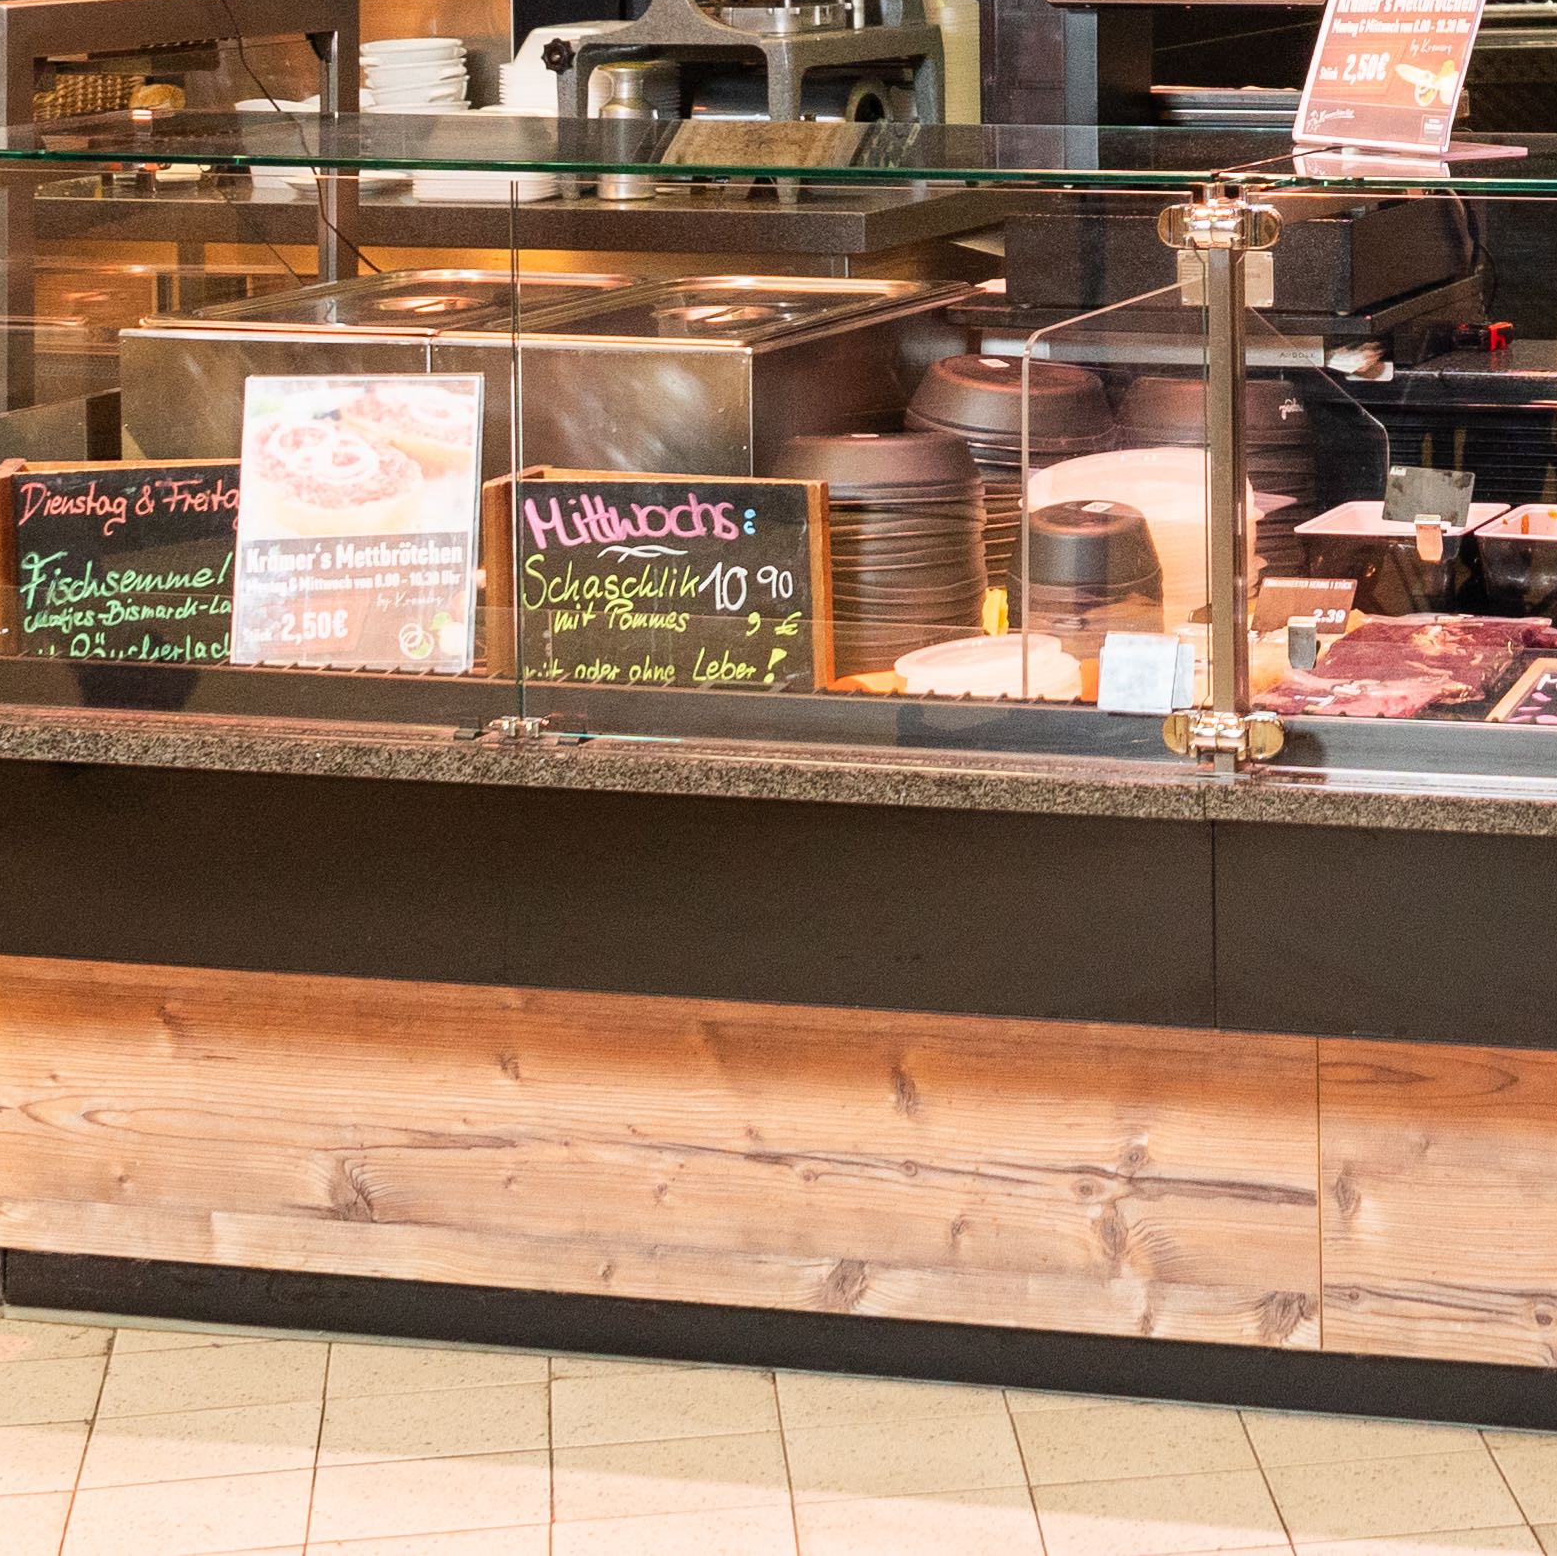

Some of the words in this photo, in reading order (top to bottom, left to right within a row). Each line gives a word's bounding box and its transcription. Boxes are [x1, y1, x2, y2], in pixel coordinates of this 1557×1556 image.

[1342, 52, 1390, 85] 2,50€
[18, 481, 127, 536] Dienstag
[155, 479, 240, 530] Freita
[336, 540, 463, 569] Mettbrötchen
[522, 554, 700, 610] Schaschlik
[281, 609, 348, 645] 2,50€
[555, 606, 596, 634] mit
[605, 598, 690, 633] Pommes
[629, 655, 675, 682] ohne
